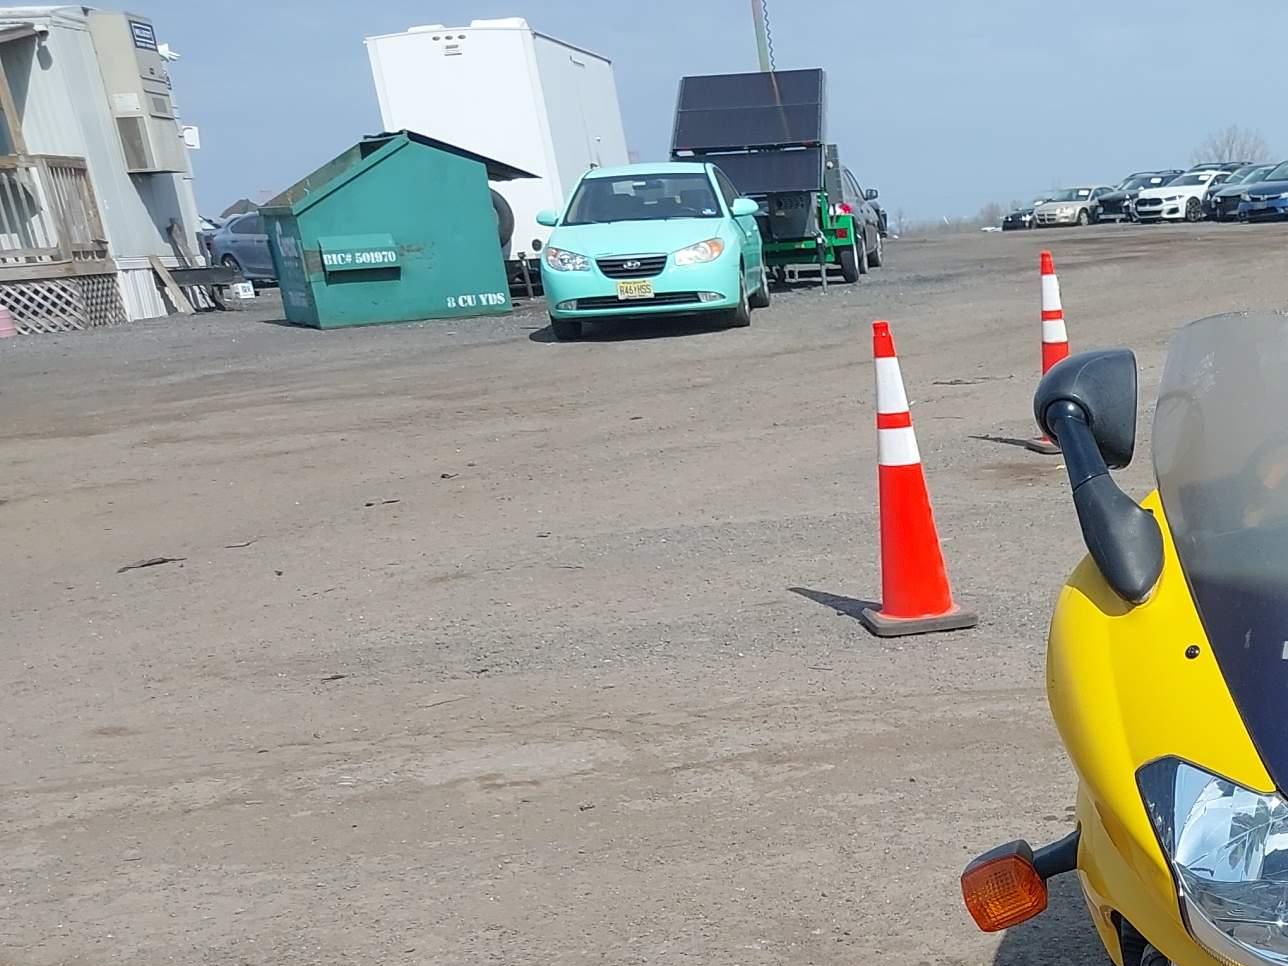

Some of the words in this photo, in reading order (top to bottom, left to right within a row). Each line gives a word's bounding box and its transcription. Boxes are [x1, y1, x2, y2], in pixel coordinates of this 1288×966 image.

[323, 253, 352, 265] BIC#
[355, 250, 397, 264] 501970
[446, 296, 457, 308] 8
[458, 294, 477, 307] CU
[478, 292, 506, 305] YDS
